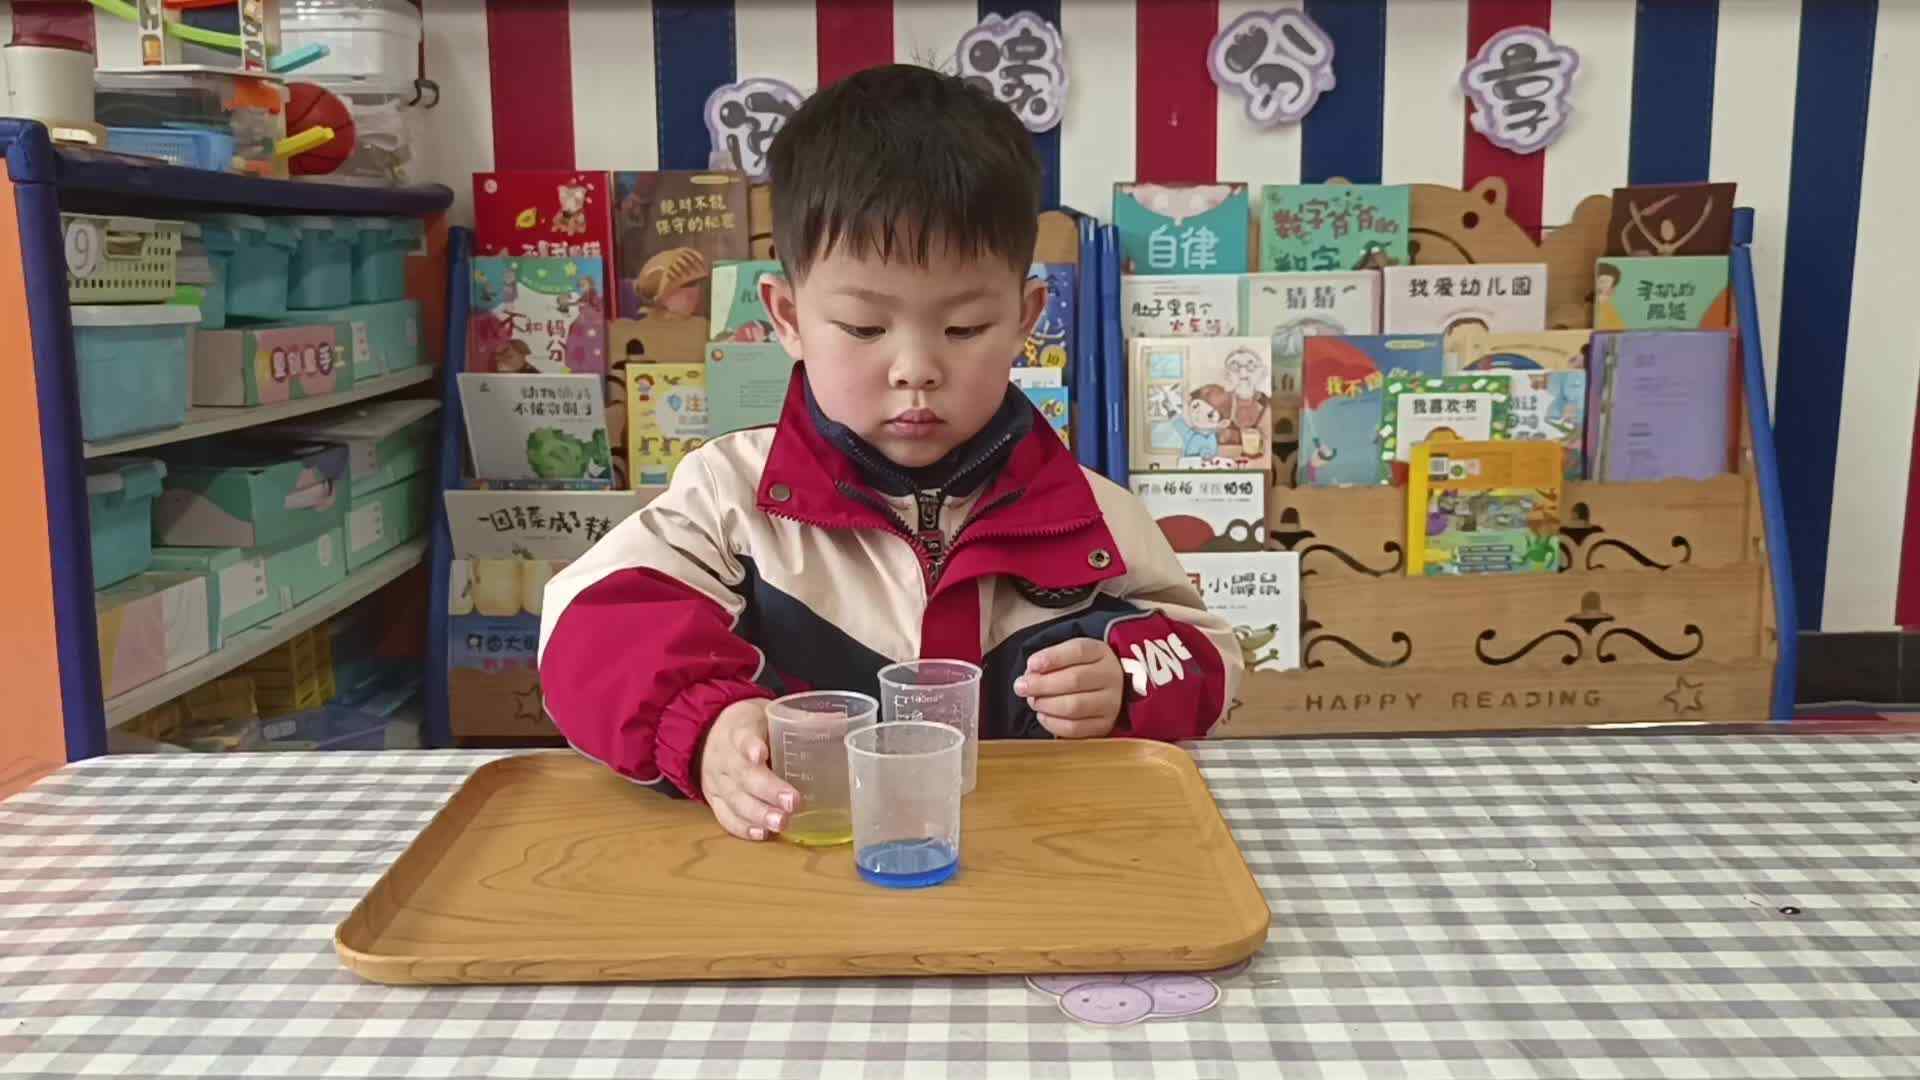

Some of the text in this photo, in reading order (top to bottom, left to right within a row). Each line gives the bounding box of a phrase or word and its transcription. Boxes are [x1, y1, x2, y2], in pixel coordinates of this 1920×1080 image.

[1480, 43, 1561, 137] 享
[74, 228, 88, 270] 9
[1148, 224, 1220, 269] 自律
[1286, 286, 1335, 309] 猜猜
[1409, 276, 1532, 297] 我爱幼儿园
[1413, 399, 1477, 414] 我喜欢书
[1306, 690, 1602, 712] HAPPY READING
